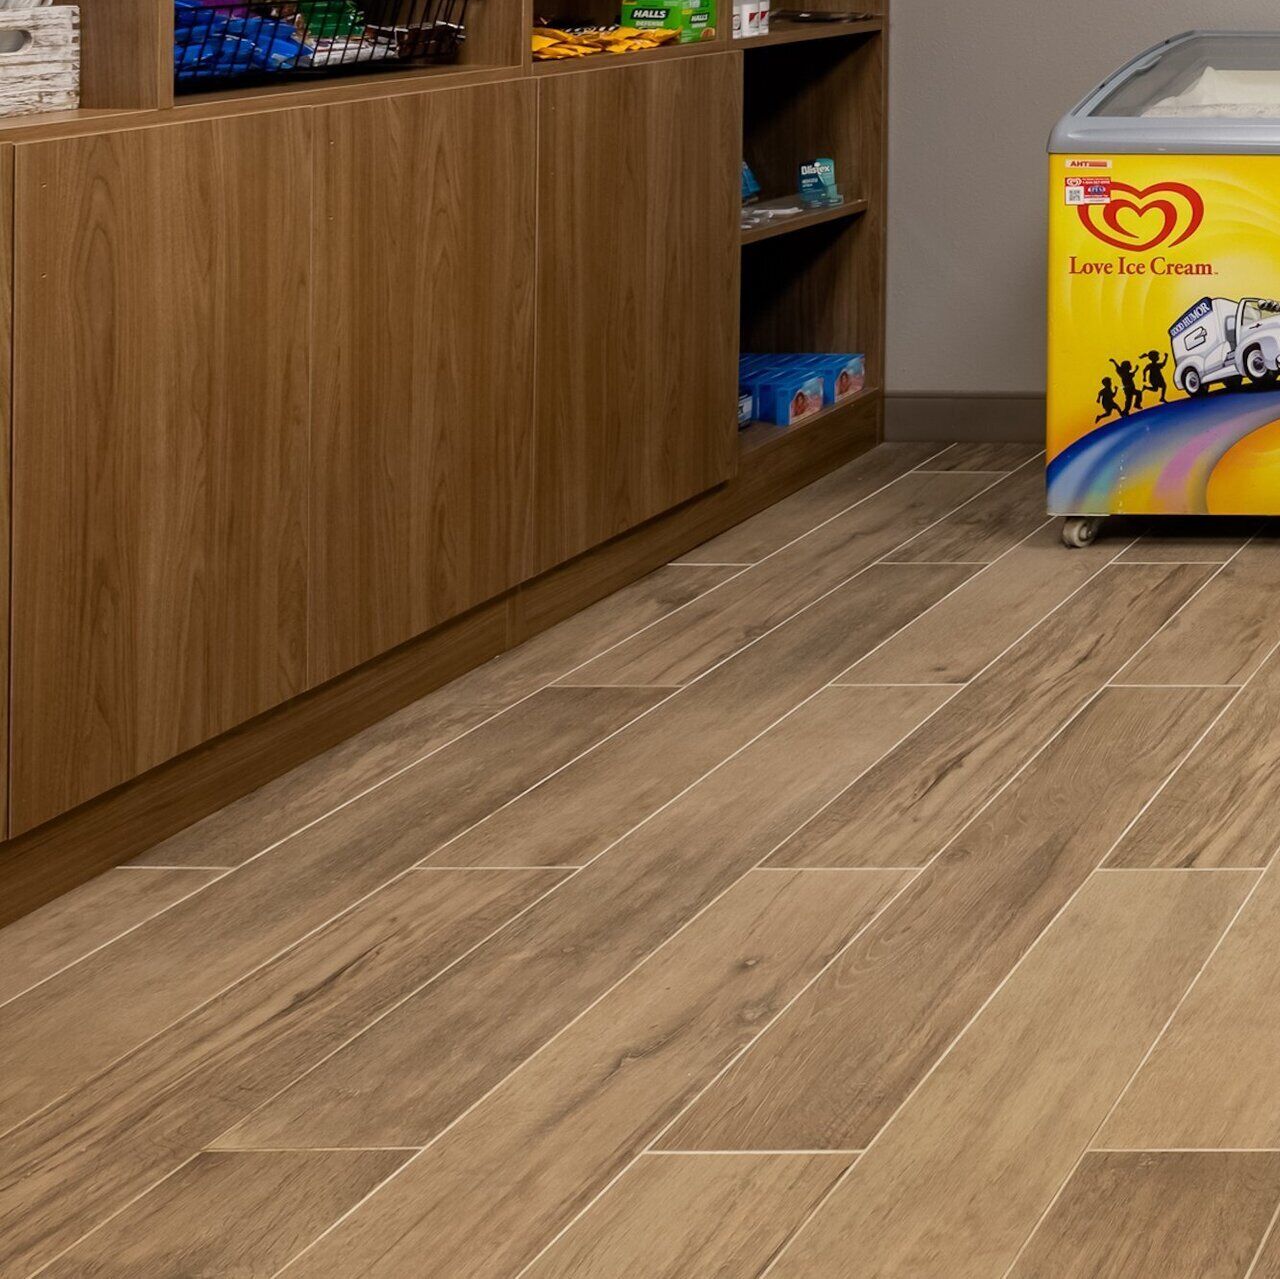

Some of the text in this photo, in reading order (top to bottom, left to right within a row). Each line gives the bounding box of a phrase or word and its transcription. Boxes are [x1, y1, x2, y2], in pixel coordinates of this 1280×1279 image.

[633, 10, 667, 19] HALLS
[691, 14, 708, 22] HALLS
[1069, 256, 1213, 276] Love Ice Cream
[1182, 302, 1210, 328] HUMOR
